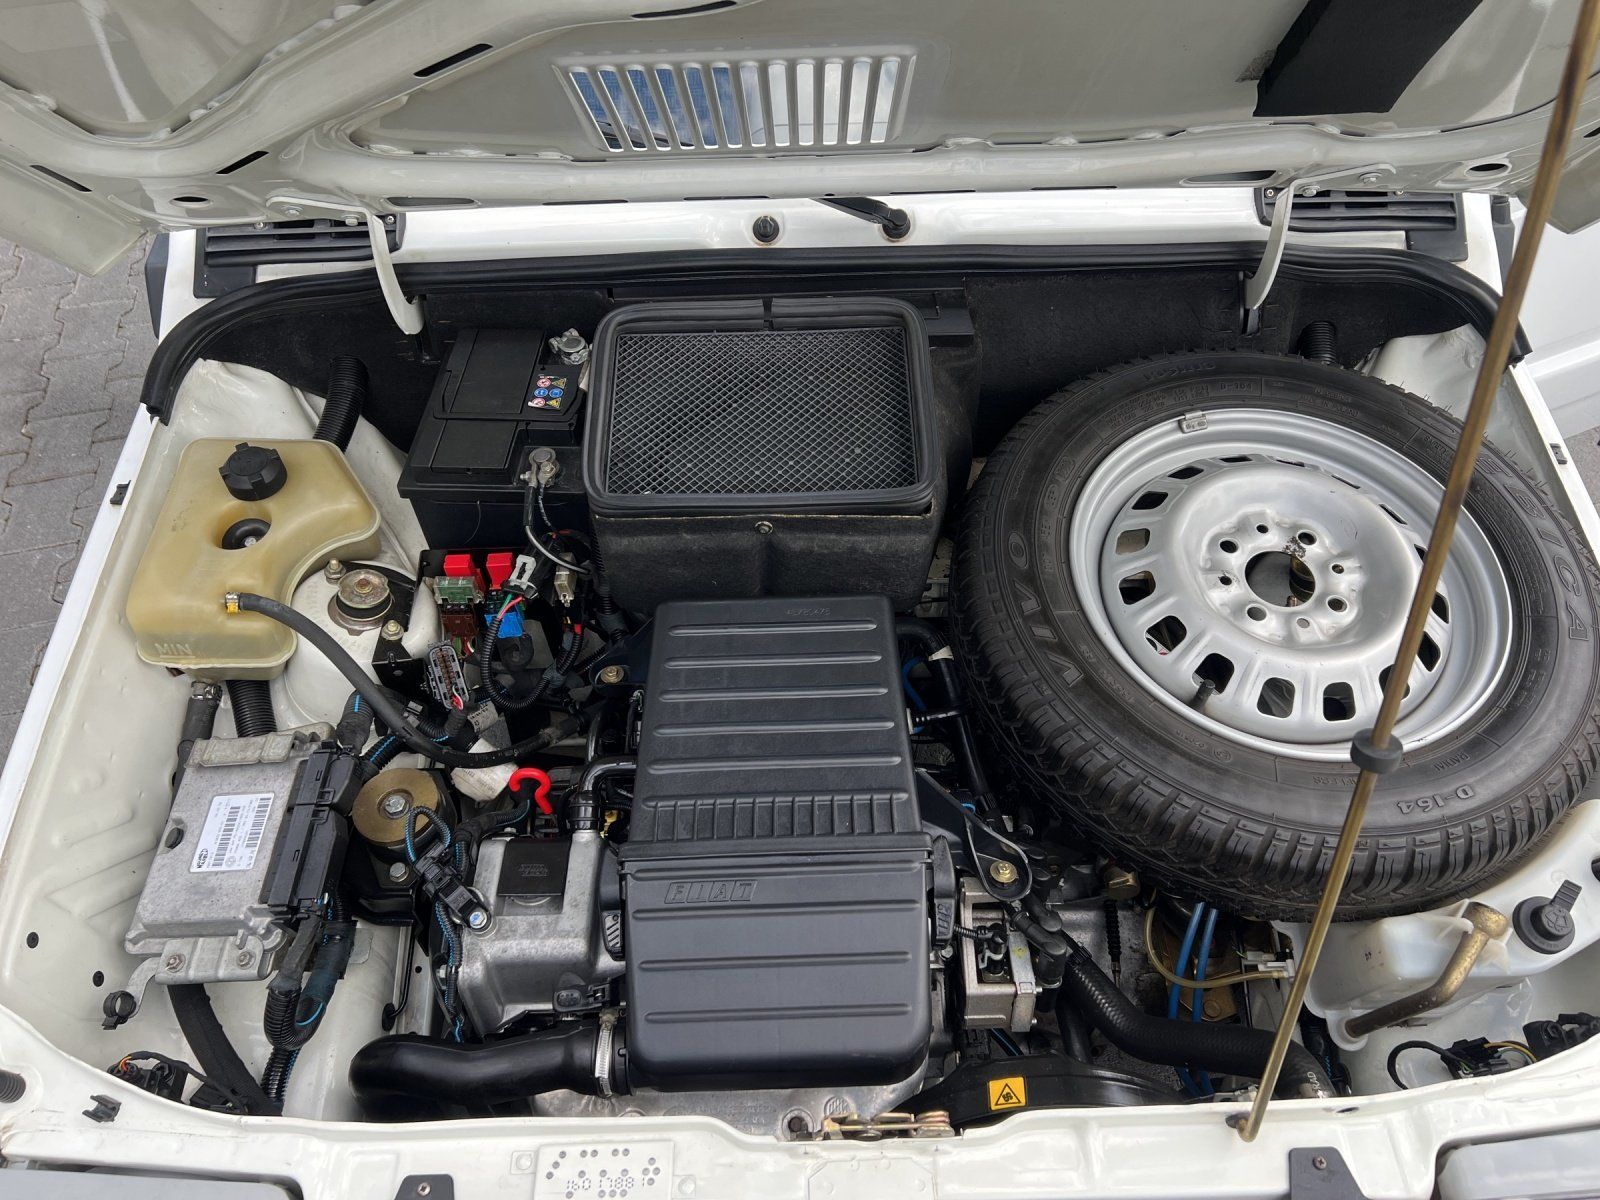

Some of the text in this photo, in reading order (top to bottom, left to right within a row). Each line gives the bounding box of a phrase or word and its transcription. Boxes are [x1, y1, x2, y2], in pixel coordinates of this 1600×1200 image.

[1008, 531, 1083, 687] VIVO
[154, 643, 193, 656] MIN
[1397, 785, 1475, 814] D-164
[667, 881, 756, 902] FIAT
